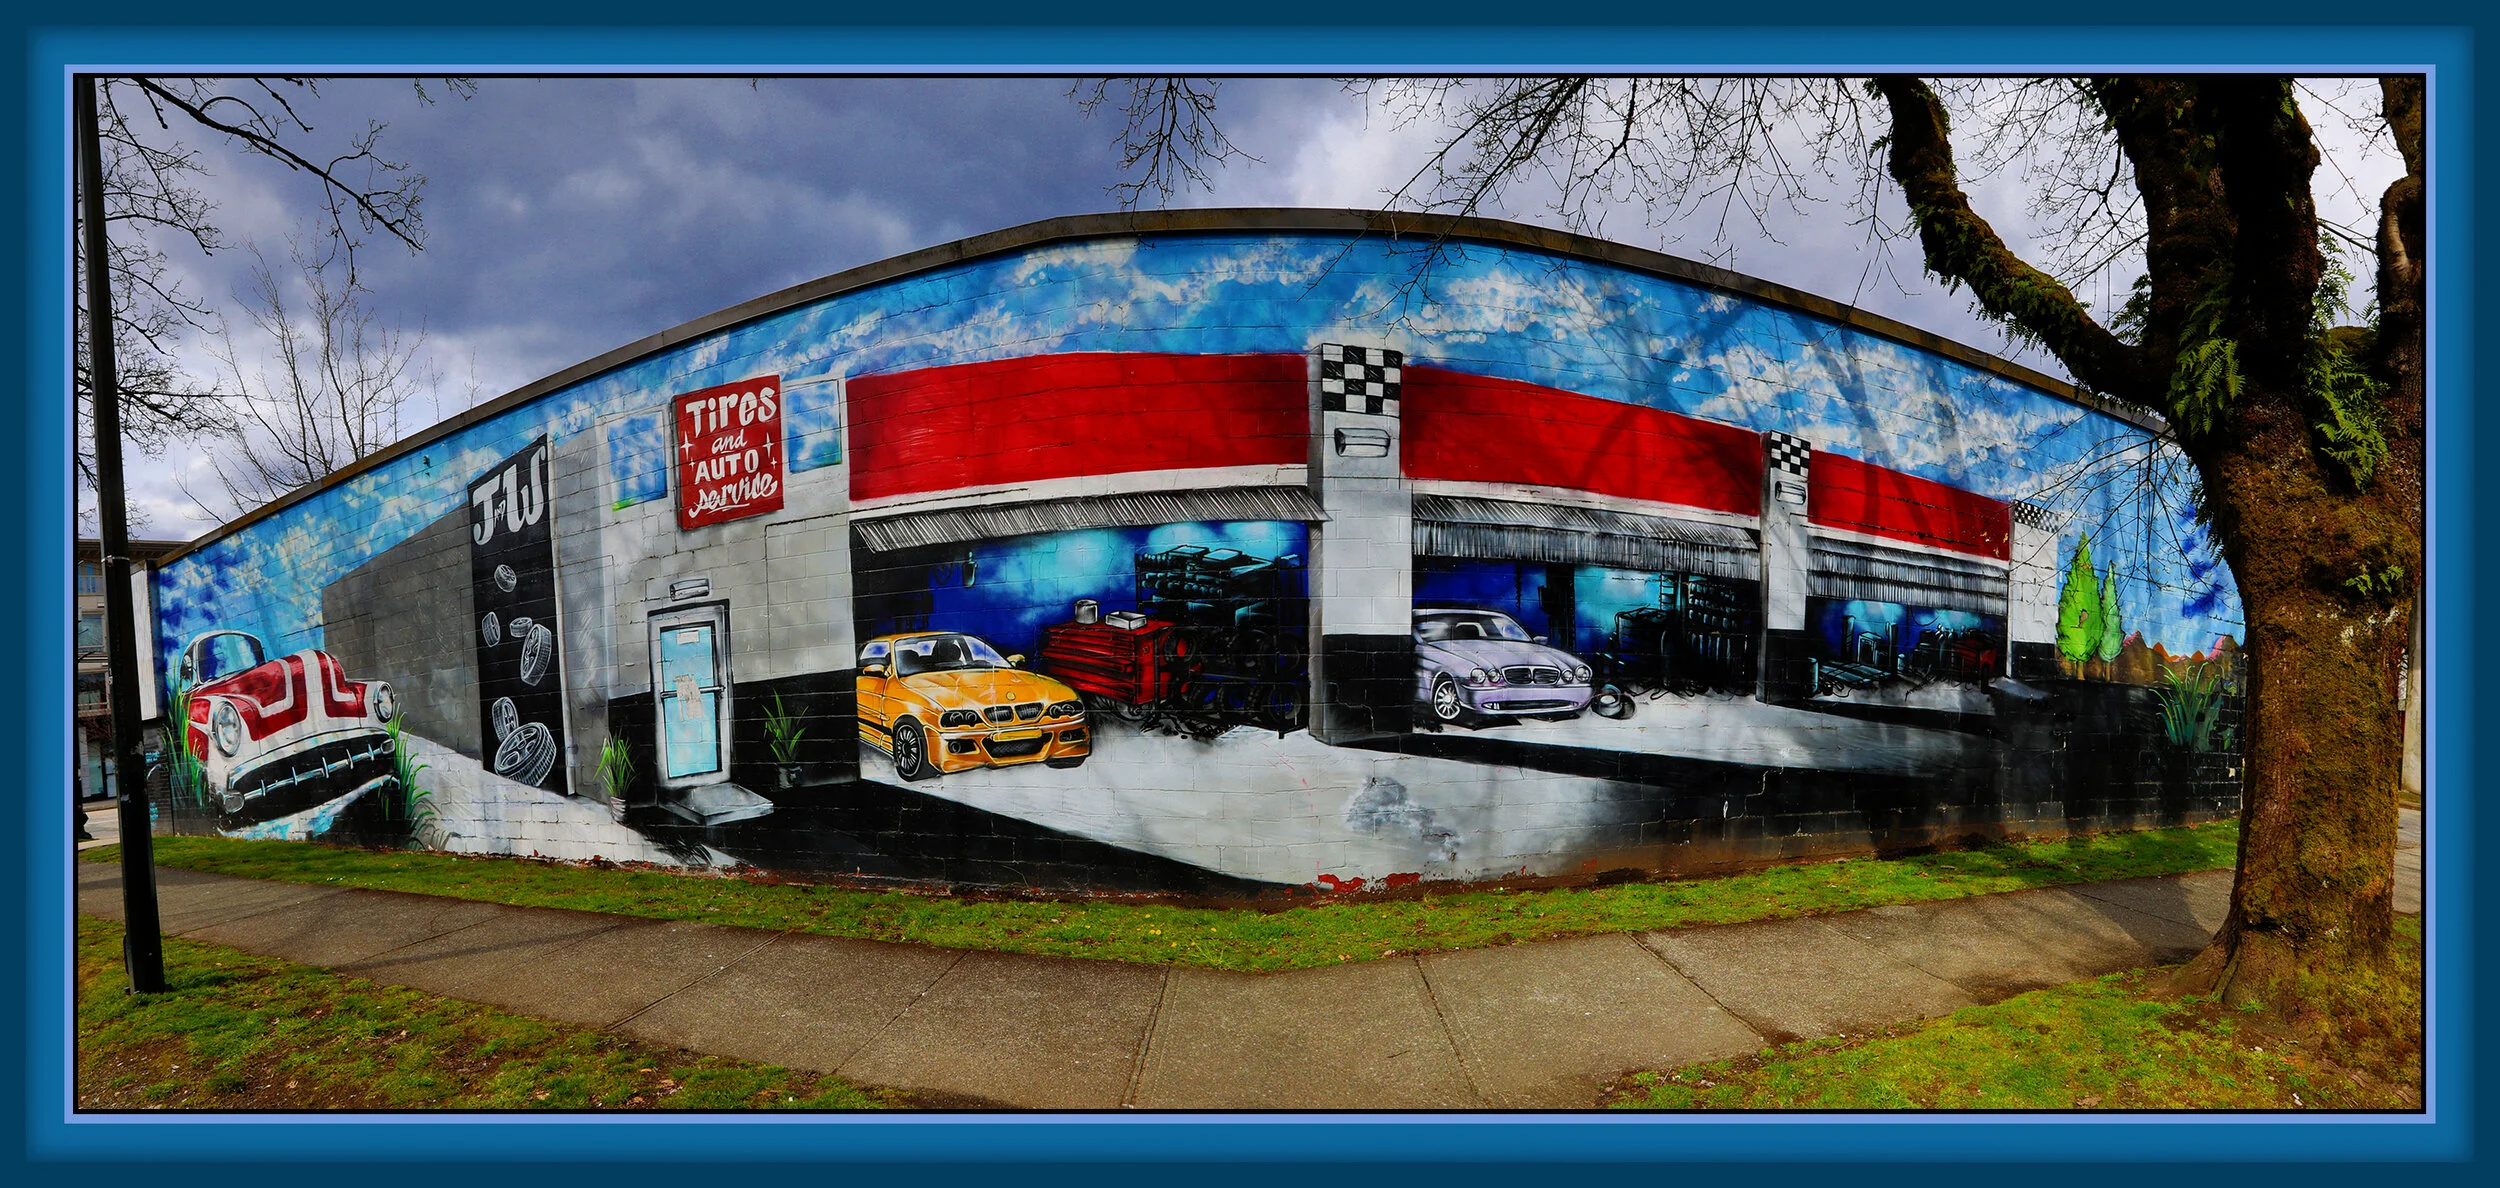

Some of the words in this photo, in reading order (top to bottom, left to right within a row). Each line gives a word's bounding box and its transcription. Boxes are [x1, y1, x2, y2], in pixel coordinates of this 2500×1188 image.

[686, 387, 777, 438] Tires
[712, 429, 748, 454] and
[695, 449, 759, 485] AUTO
[473, 473, 500, 545] J
[503, 446, 546, 533] W
[688, 472, 778, 518] service
